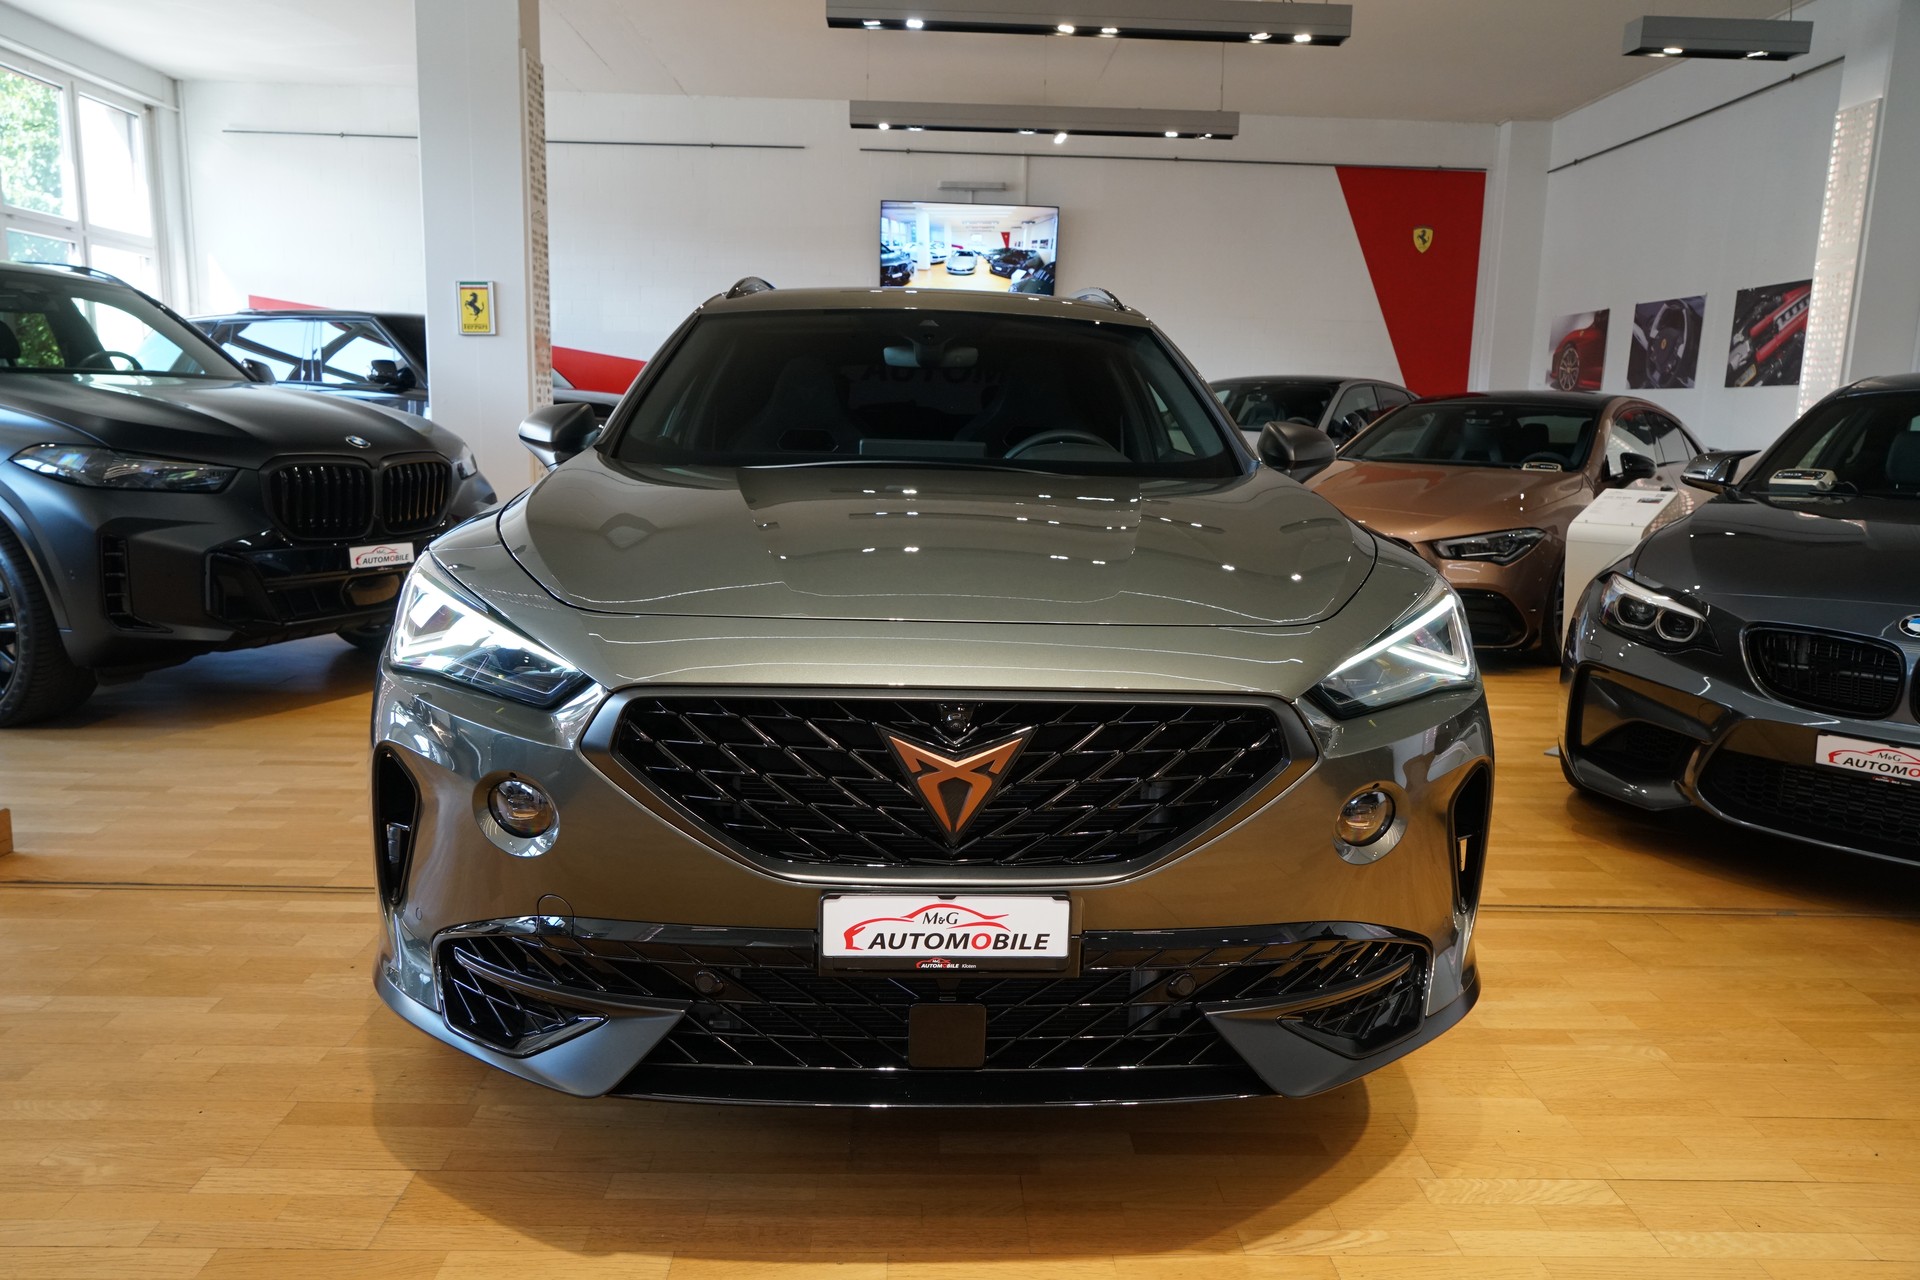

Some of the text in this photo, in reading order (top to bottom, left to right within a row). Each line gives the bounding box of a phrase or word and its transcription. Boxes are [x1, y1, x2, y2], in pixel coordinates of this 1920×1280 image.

[362, 554, 408, 565] AUTOMOBILE
[922, 912, 959, 925] M&G
[868, 933, 1050, 950] AUTOMOBILE
